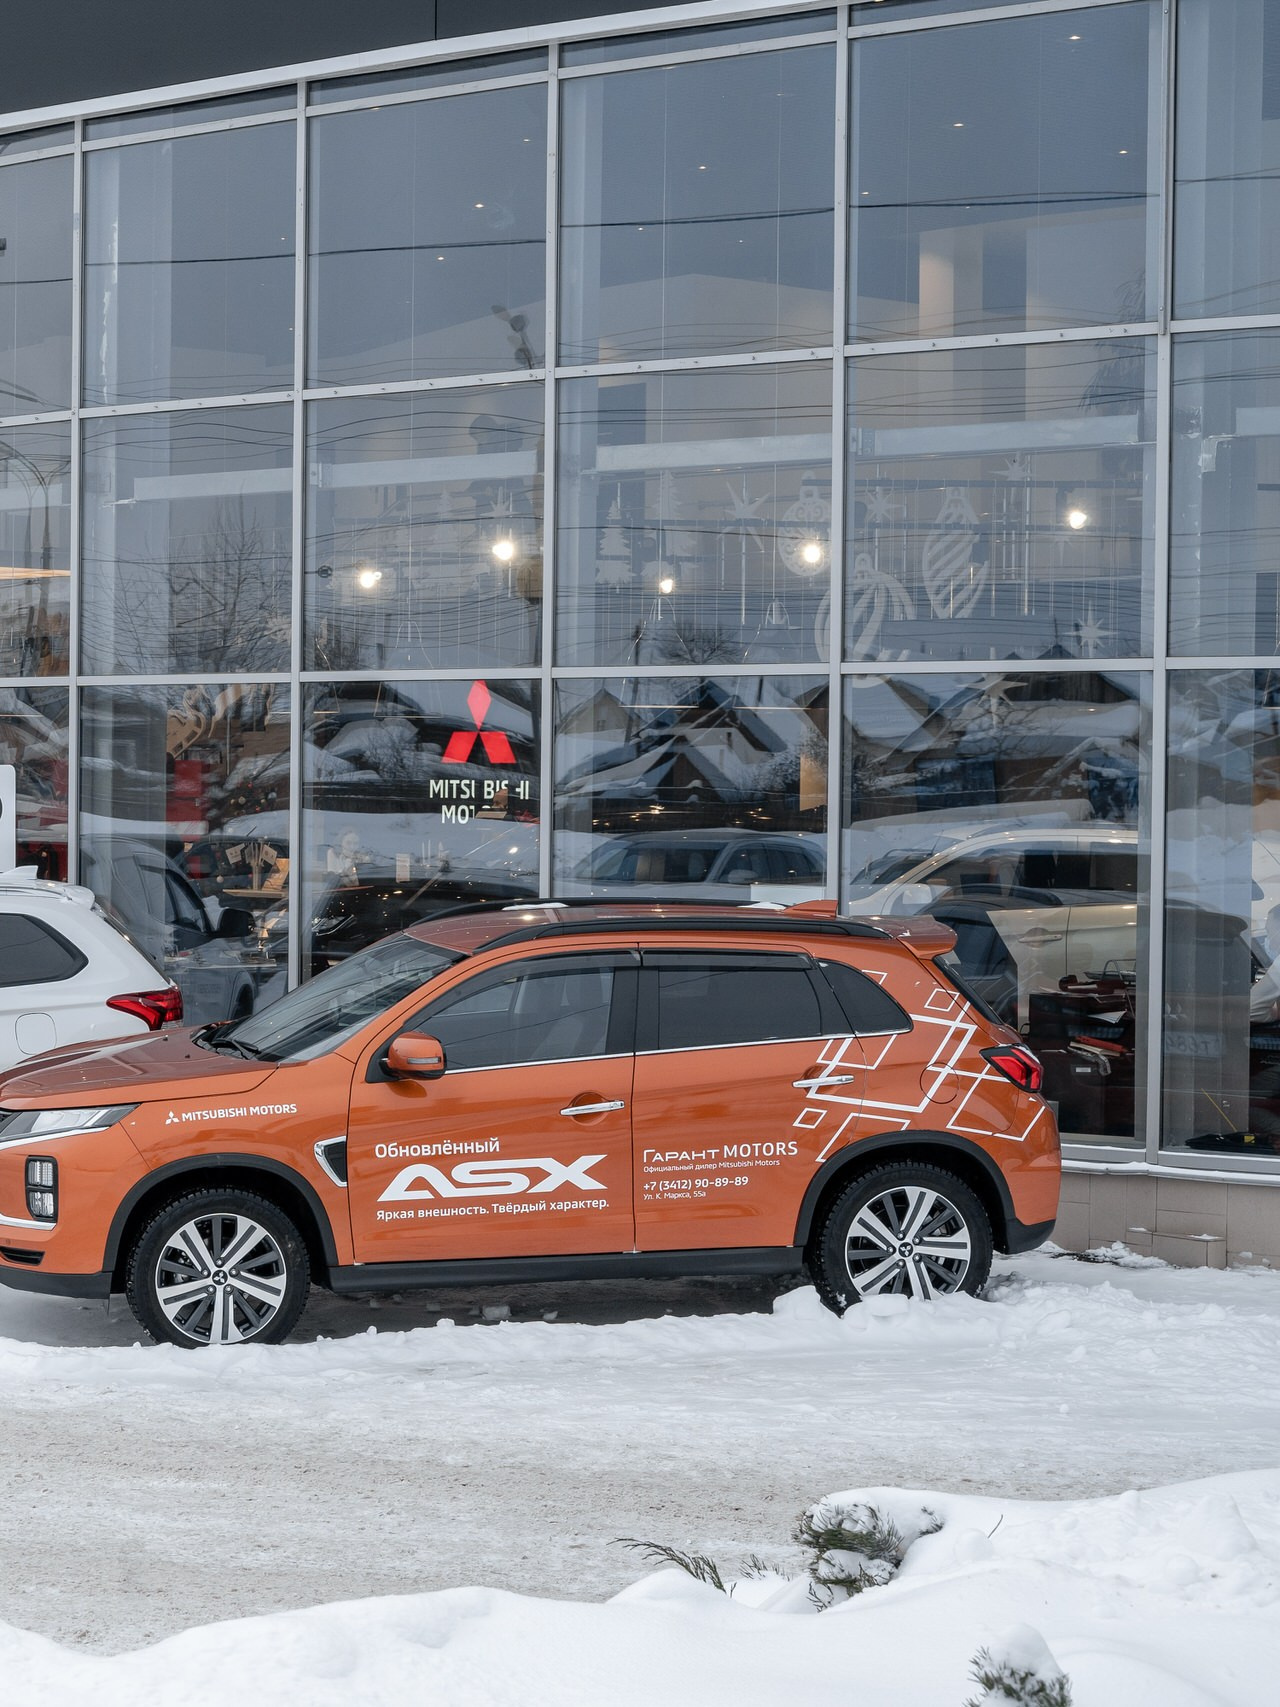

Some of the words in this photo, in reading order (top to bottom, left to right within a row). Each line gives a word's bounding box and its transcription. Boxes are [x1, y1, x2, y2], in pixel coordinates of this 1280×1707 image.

[181, 1107, 247, 1122] MITSUBISHI
[249, 1103, 297, 1116] MOTORS
[374, 1137, 501, 1159] Обновлённый
[723, 1141, 798, 1159] MOTORS
[643, 1163, 694, 1173] Официальный
[694, 1163, 717, 1171] дилер
[718, 1160, 754, 1168] Mitsubishi
[754, 1159, 780, 1167] Motors
[376, 1154, 609, 1203] ASX
[643, 1181, 657, 1191] +7
[659, 1179, 692, 1192] (3412)
[694, 1176, 749, 1189] 90-89-89
[663, 1191, 692, 1200] Маркса,
[693, 1190, 706, 1198] 55а
[376, 1209, 415, 1221] Яркая
[417, 1205, 490, 1218] внешность.
[491, 1200, 547, 1215] Твёрдый
[549, 1197, 610, 1212] характер.
